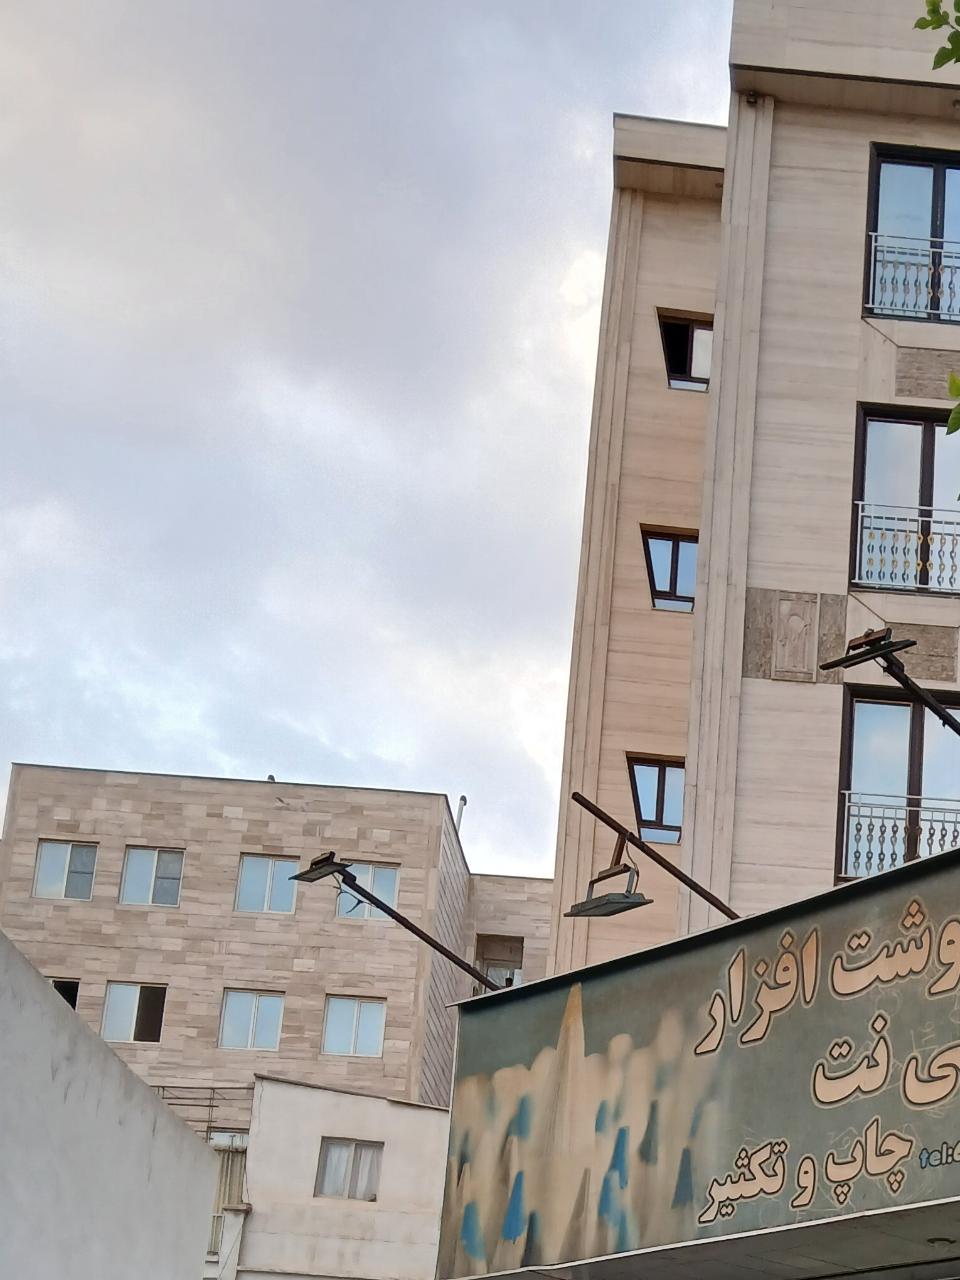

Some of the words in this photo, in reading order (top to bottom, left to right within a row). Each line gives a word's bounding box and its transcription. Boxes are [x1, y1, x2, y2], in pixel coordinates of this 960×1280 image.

[695, 929, 820, 1056] افزار
[813, 1013, 889, 1106] نت
[698, 1140, 787, 1224] تکثیر
[790, 1155, 816, 1208] و
[824, 1117, 913, 1206] چاپ
